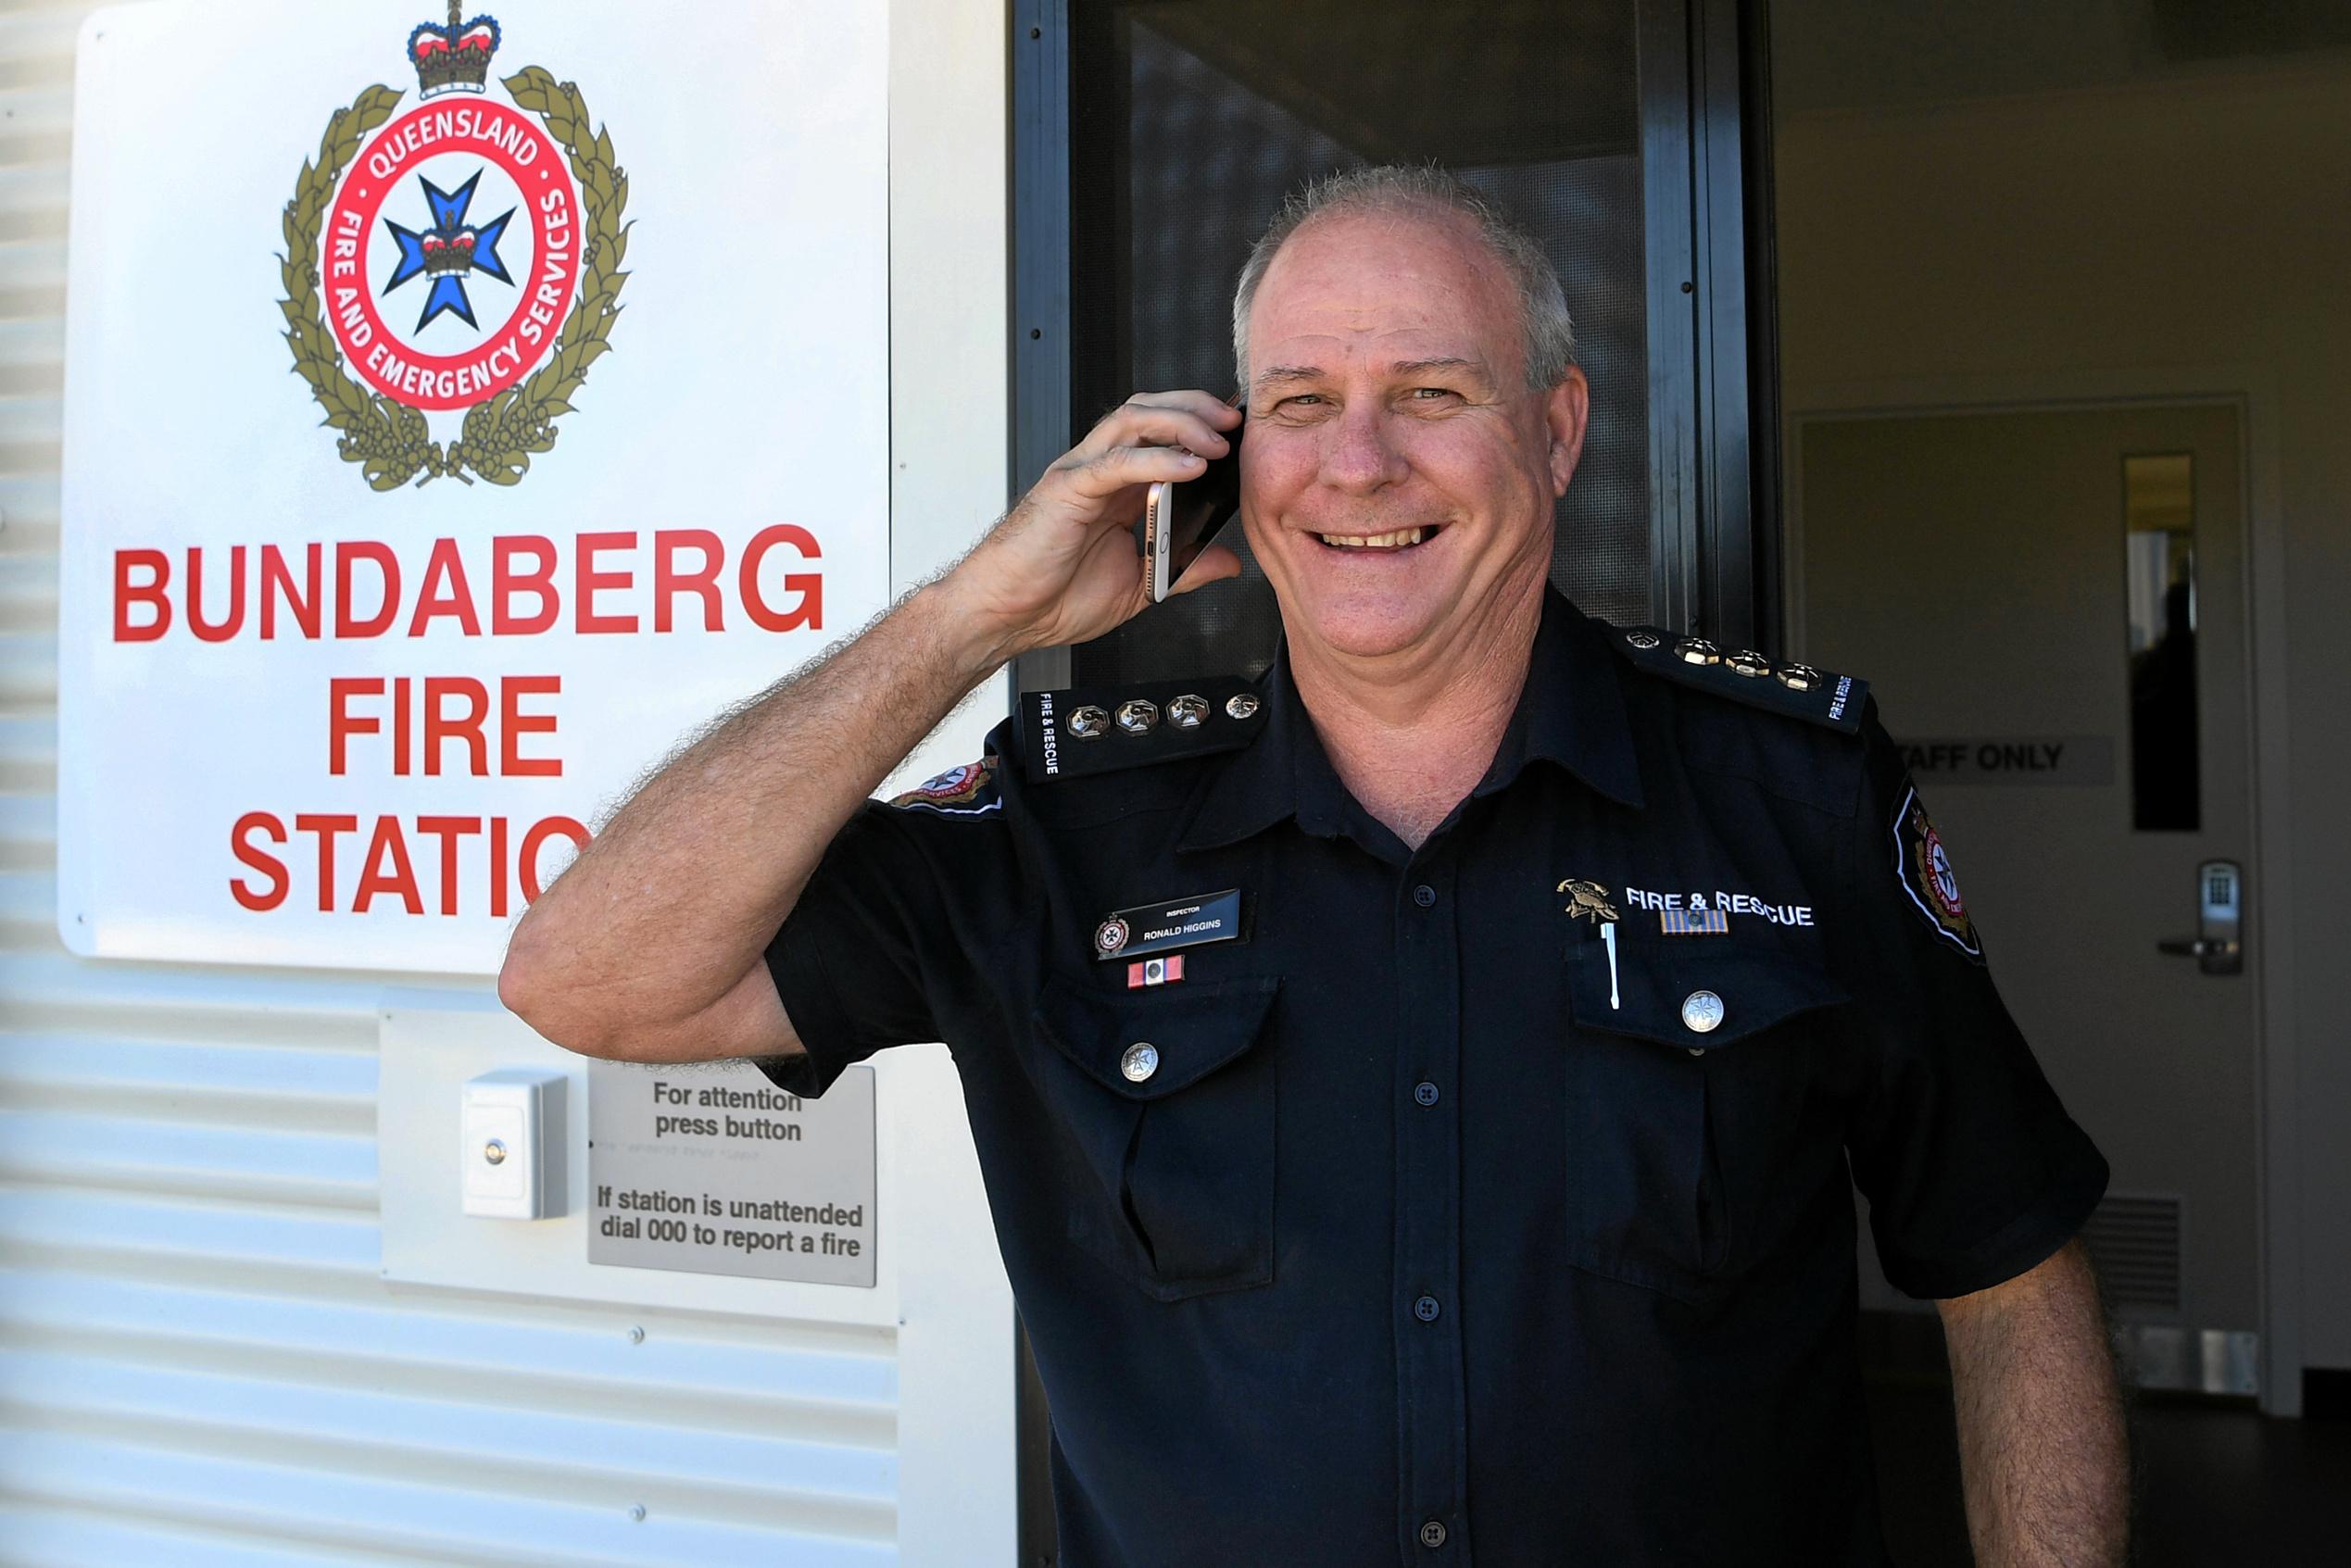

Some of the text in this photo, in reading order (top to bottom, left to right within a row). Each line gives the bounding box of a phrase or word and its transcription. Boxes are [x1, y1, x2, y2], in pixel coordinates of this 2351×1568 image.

[370, 108, 538, 180] QUEENSLAND
[333, 189, 570, 399] FIRE AND EMERGENCY SERVICES
[112, 524, 824, 643] BUNDABERG
[329, 675, 563, 777] FIRE
[1040, 693, 1059, 774] FIRE & RESCUE
[1897, 743, 2064, 771] TAFF ONLY
[229, 811, 594, 917] STATIO
[1166, 905, 1201, 918] INSPECTOR
[1626, 886, 1815, 926] FIRE & RESCUE
[1144, 919, 1221, 941] RONALD HIGGINS
[654, 1082, 803, 1112] For attention
[656, 1115, 802, 1142] press button
[597, 1185, 863, 1227] If station is unattended
[601, 1215, 861, 1257] dial 000 to report a fire
